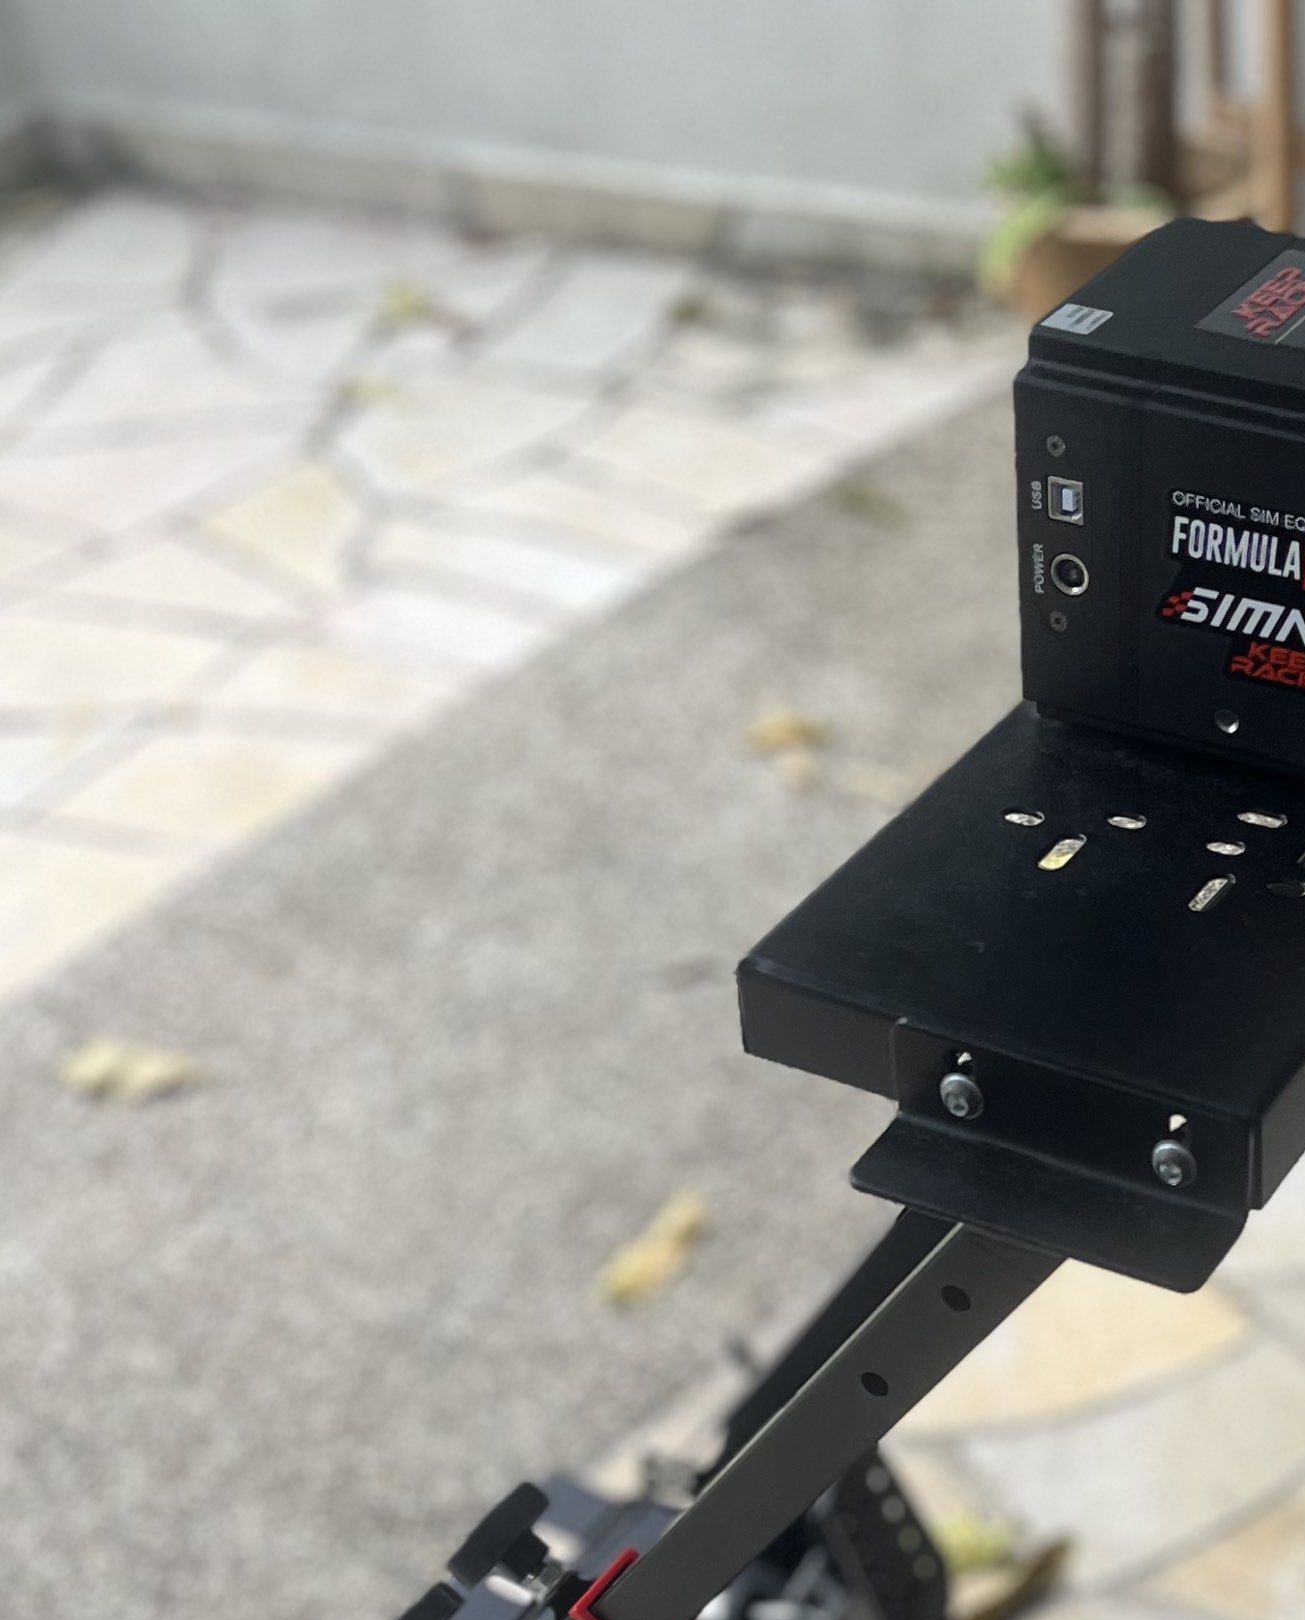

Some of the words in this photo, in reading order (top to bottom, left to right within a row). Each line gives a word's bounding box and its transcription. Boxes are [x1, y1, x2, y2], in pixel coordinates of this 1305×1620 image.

[1031, 480, 1042, 510] USB
[1172, 490, 1245, 520] OFFICIAL
[1250, 507, 1280, 526] SIM
[1033, 543, 1044, 594] POWER
[1171, 515, 1300, 580] FORMULA
